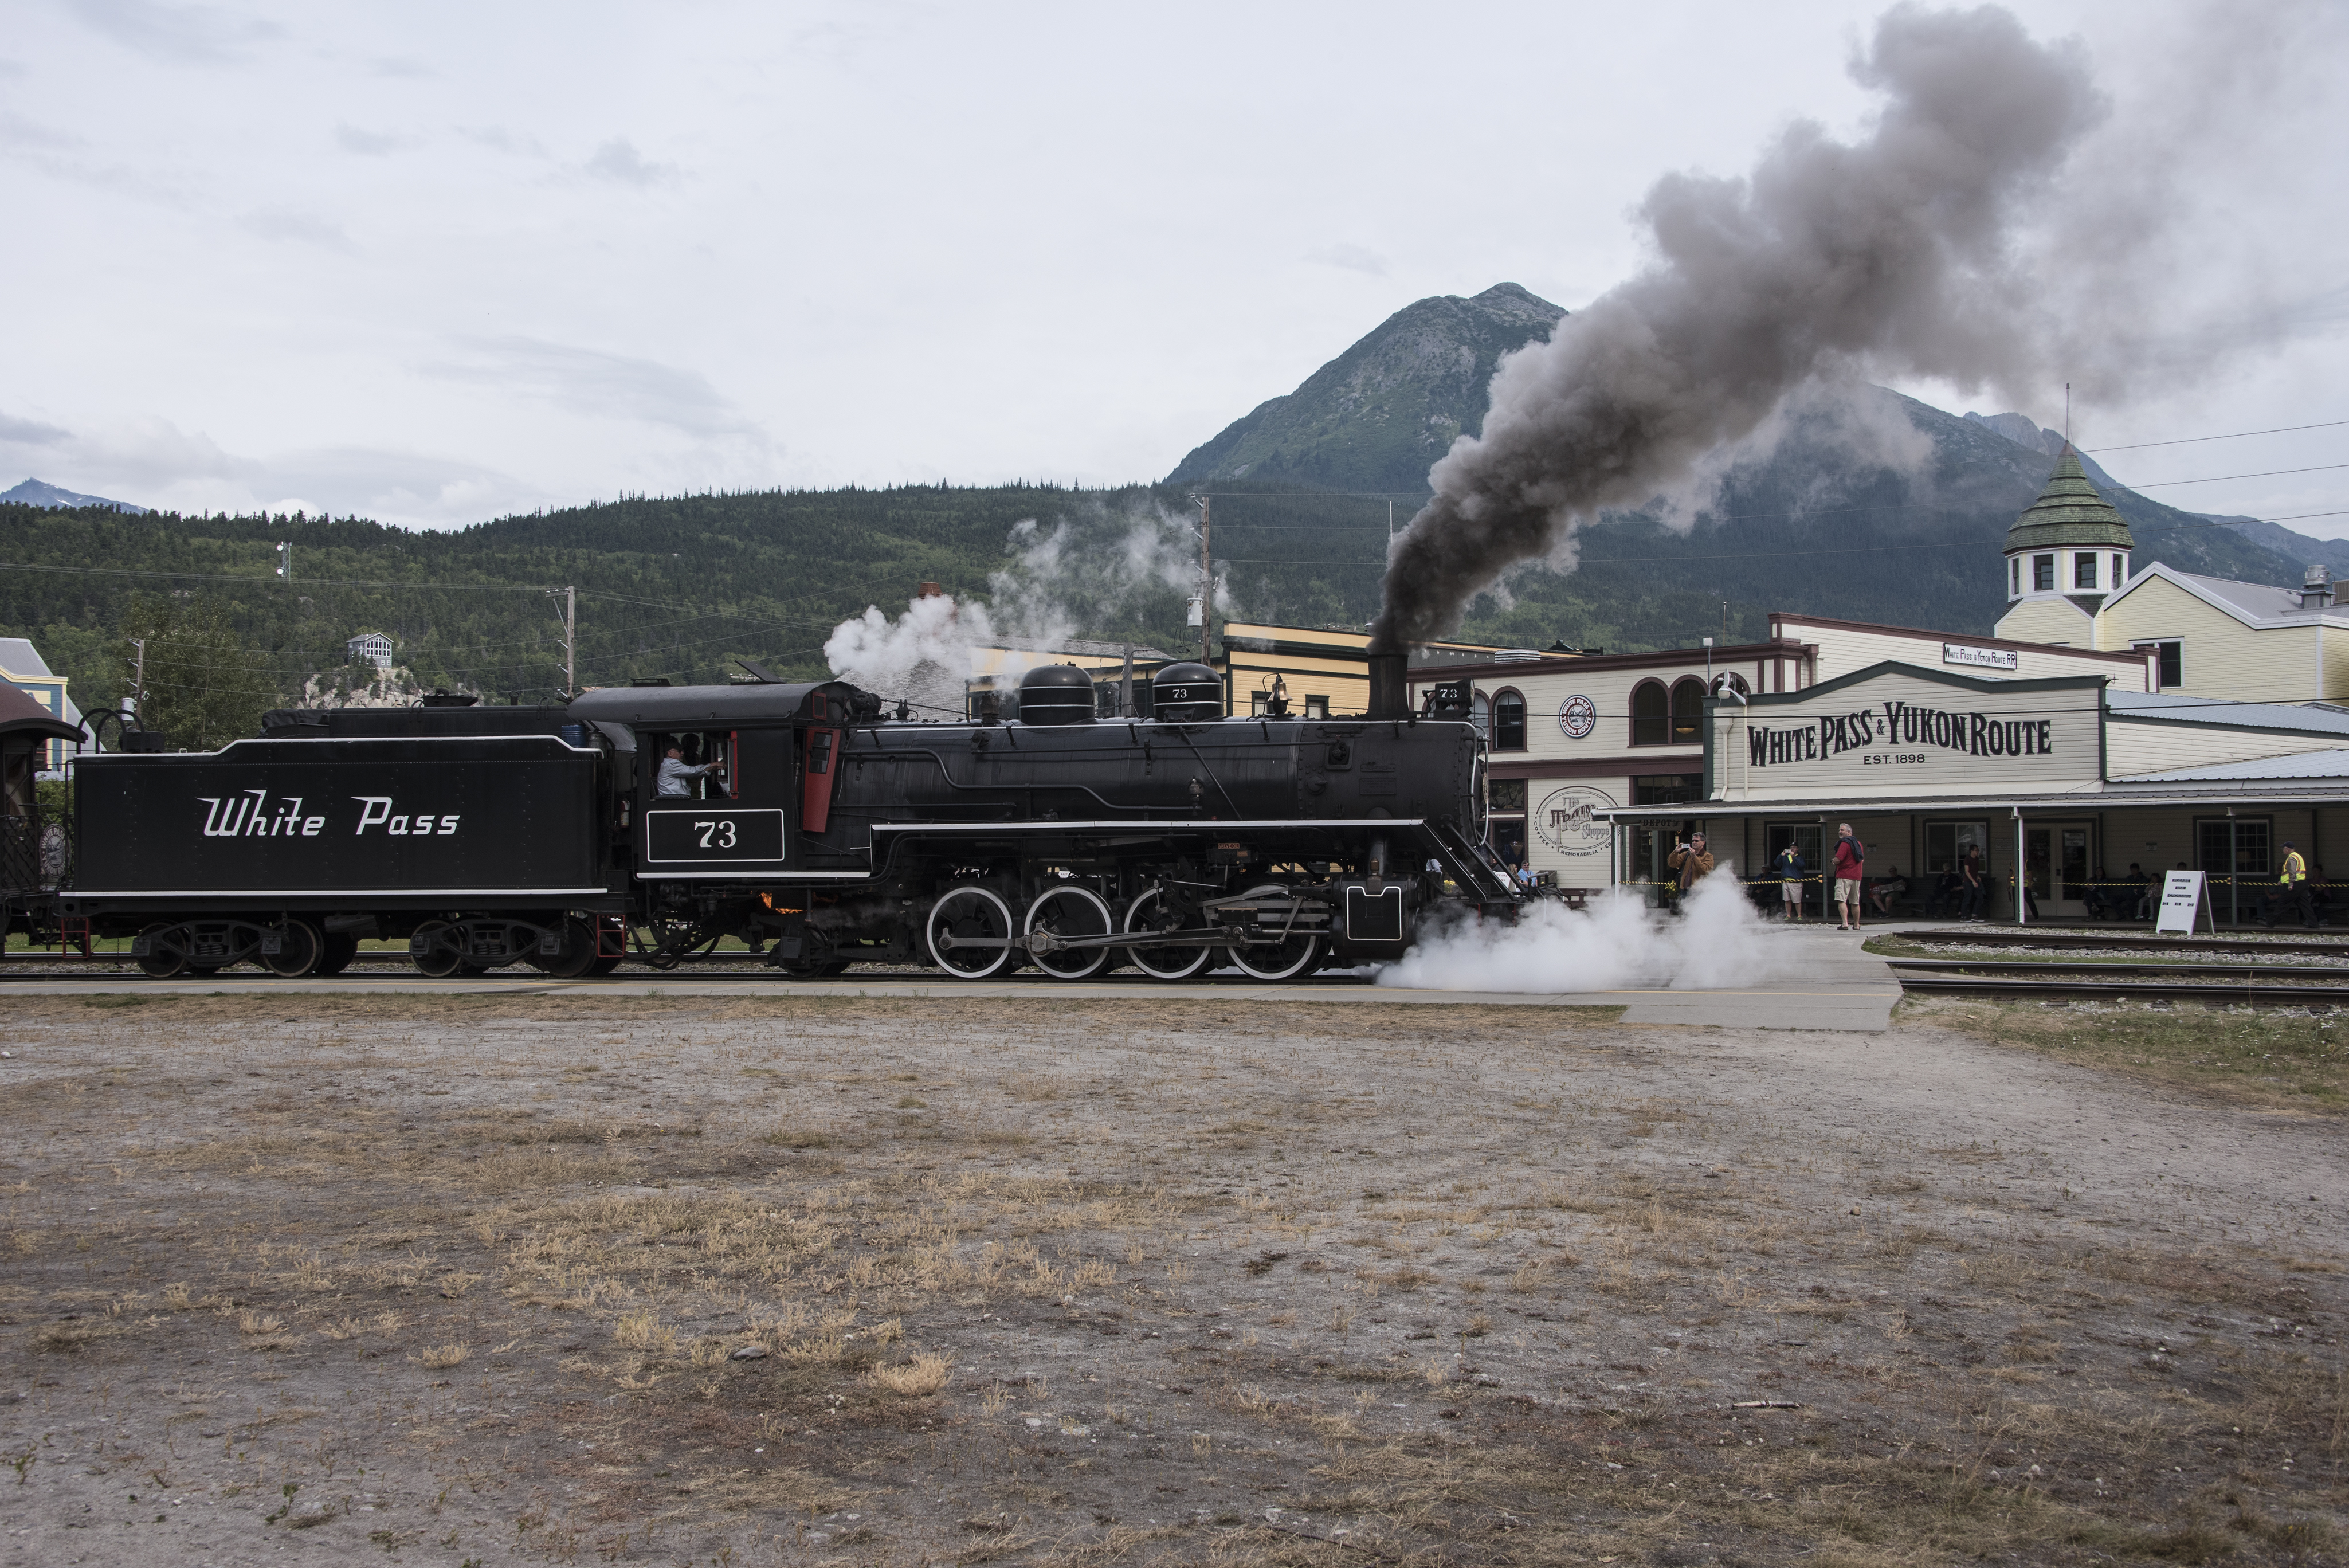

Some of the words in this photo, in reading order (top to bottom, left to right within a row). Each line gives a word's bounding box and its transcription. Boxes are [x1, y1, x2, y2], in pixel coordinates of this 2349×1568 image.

[1944, 647, 1959, 659] WHITE
[1960, 649, 1972, 660] PASS
[1977, 650, 1991, 663] YUKON
[1991, 652, 2006, 664] ROUTE
[2007, 654, 2015, 665] RR
[1172, 689, 1187, 698] 73
[1440, 689, 1457, 698] 73
[1562, 699, 1576, 714] WHITE
[1577, 698, 1590, 709] PASS
[1562, 716, 1577, 734] YUKON
[1577, 716, 1592, 734] ROUTE
[1747, 725, 1817, 767] WHITE
[1819, 709, 1873, 761] PASS
[1876, 719, 1885, 735] &
[1883, 701, 1967, 752] YUKON
[1969, 712, 2052, 757] ROUTE
[1864, 755, 1891, 765] EST.
[1895, 754, 1925, 764] 1898
[1562, 796, 1590, 810] The
[197, 790, 326, 836] White
[351, 797, 460, 835] Pass
[41, 828, 54, 849] WHITE
[54, 827, 65, 840] PASS
[695, 821, 736, 848] 73
[1534, 821, 1550, 846] COFFEE
[1582, 823, 1610, 840] Shoppe
[42, 856, 57, 875] YUKON
